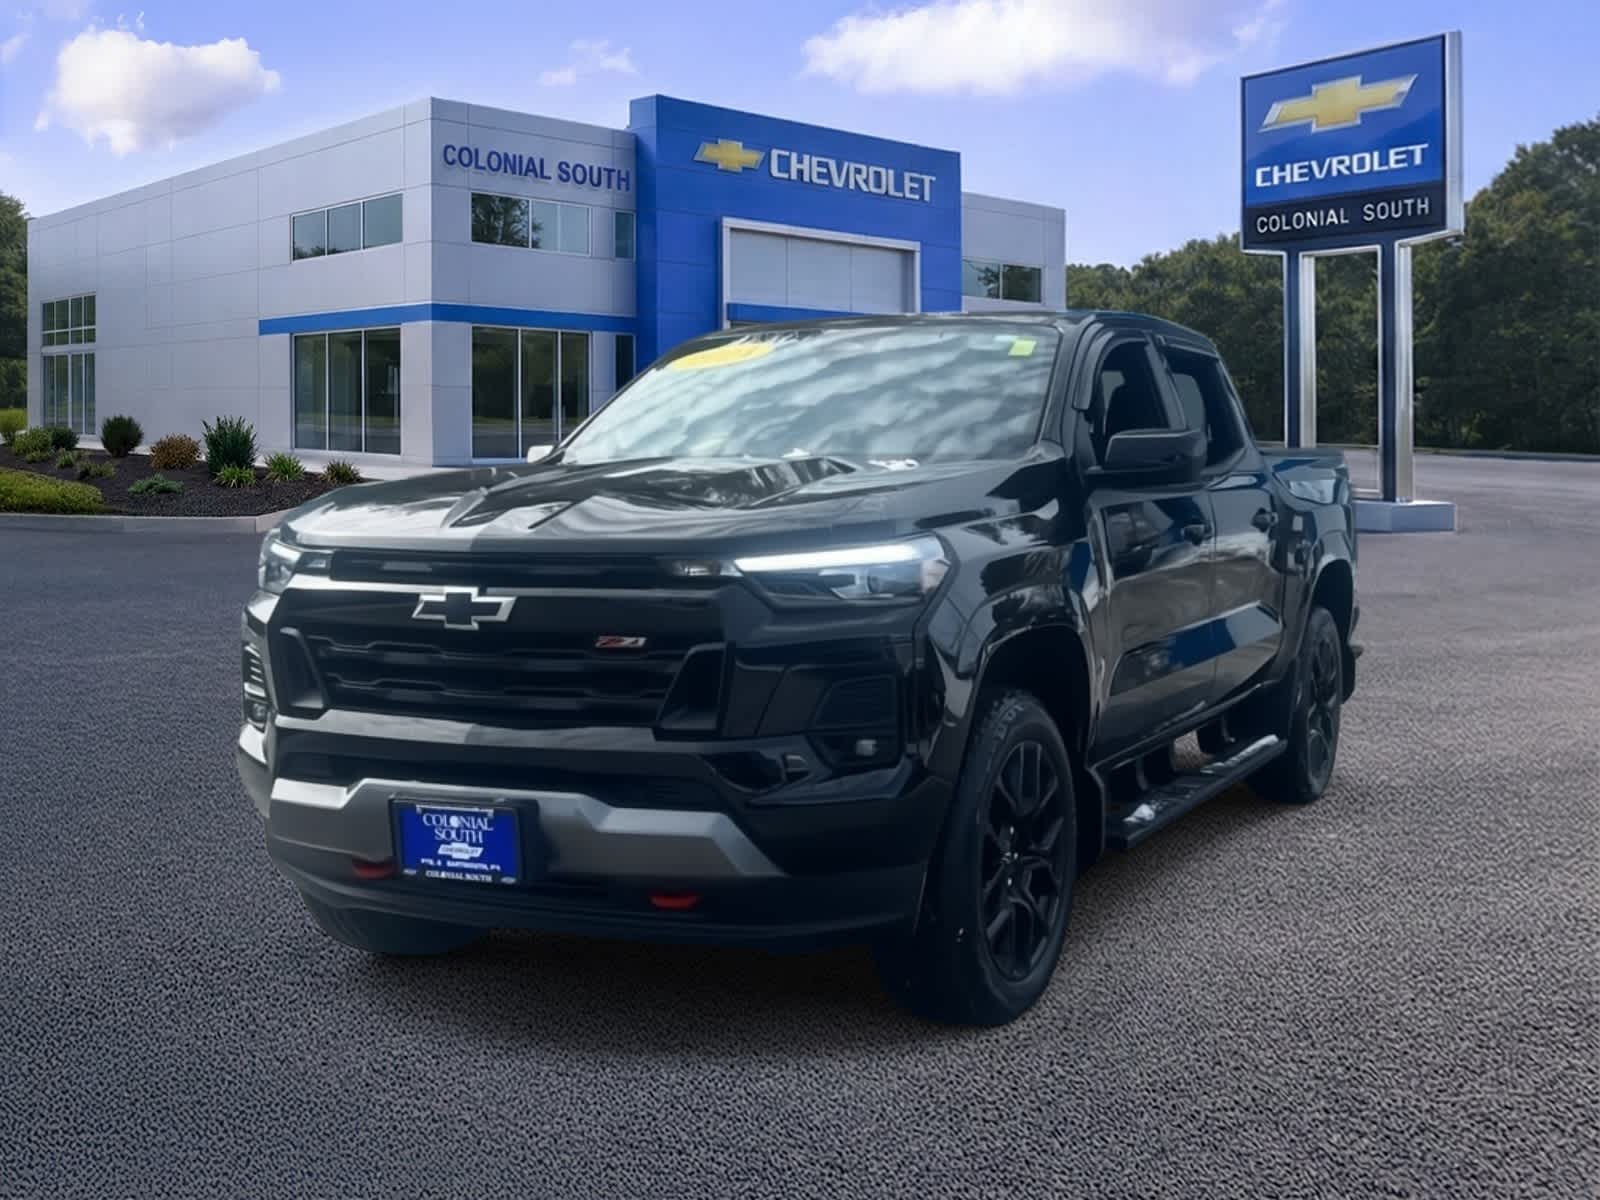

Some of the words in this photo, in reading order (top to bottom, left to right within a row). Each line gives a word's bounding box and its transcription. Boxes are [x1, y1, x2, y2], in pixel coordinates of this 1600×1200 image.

[443, 144, 552, 180] COLONIAL
[557, 161, 631, 192] SOUTH
[770, 148, 937, 203] CHEVROLET
[1255, 143, 1429, 187] CHEVROLET
[1256, 207, 1349, 234] COLONIAL
[1362, 196, 1430, 222] SOUTH
[422, 812, 494, 831] COLONIAL
[434, 827, 484, 844] SOUTH
